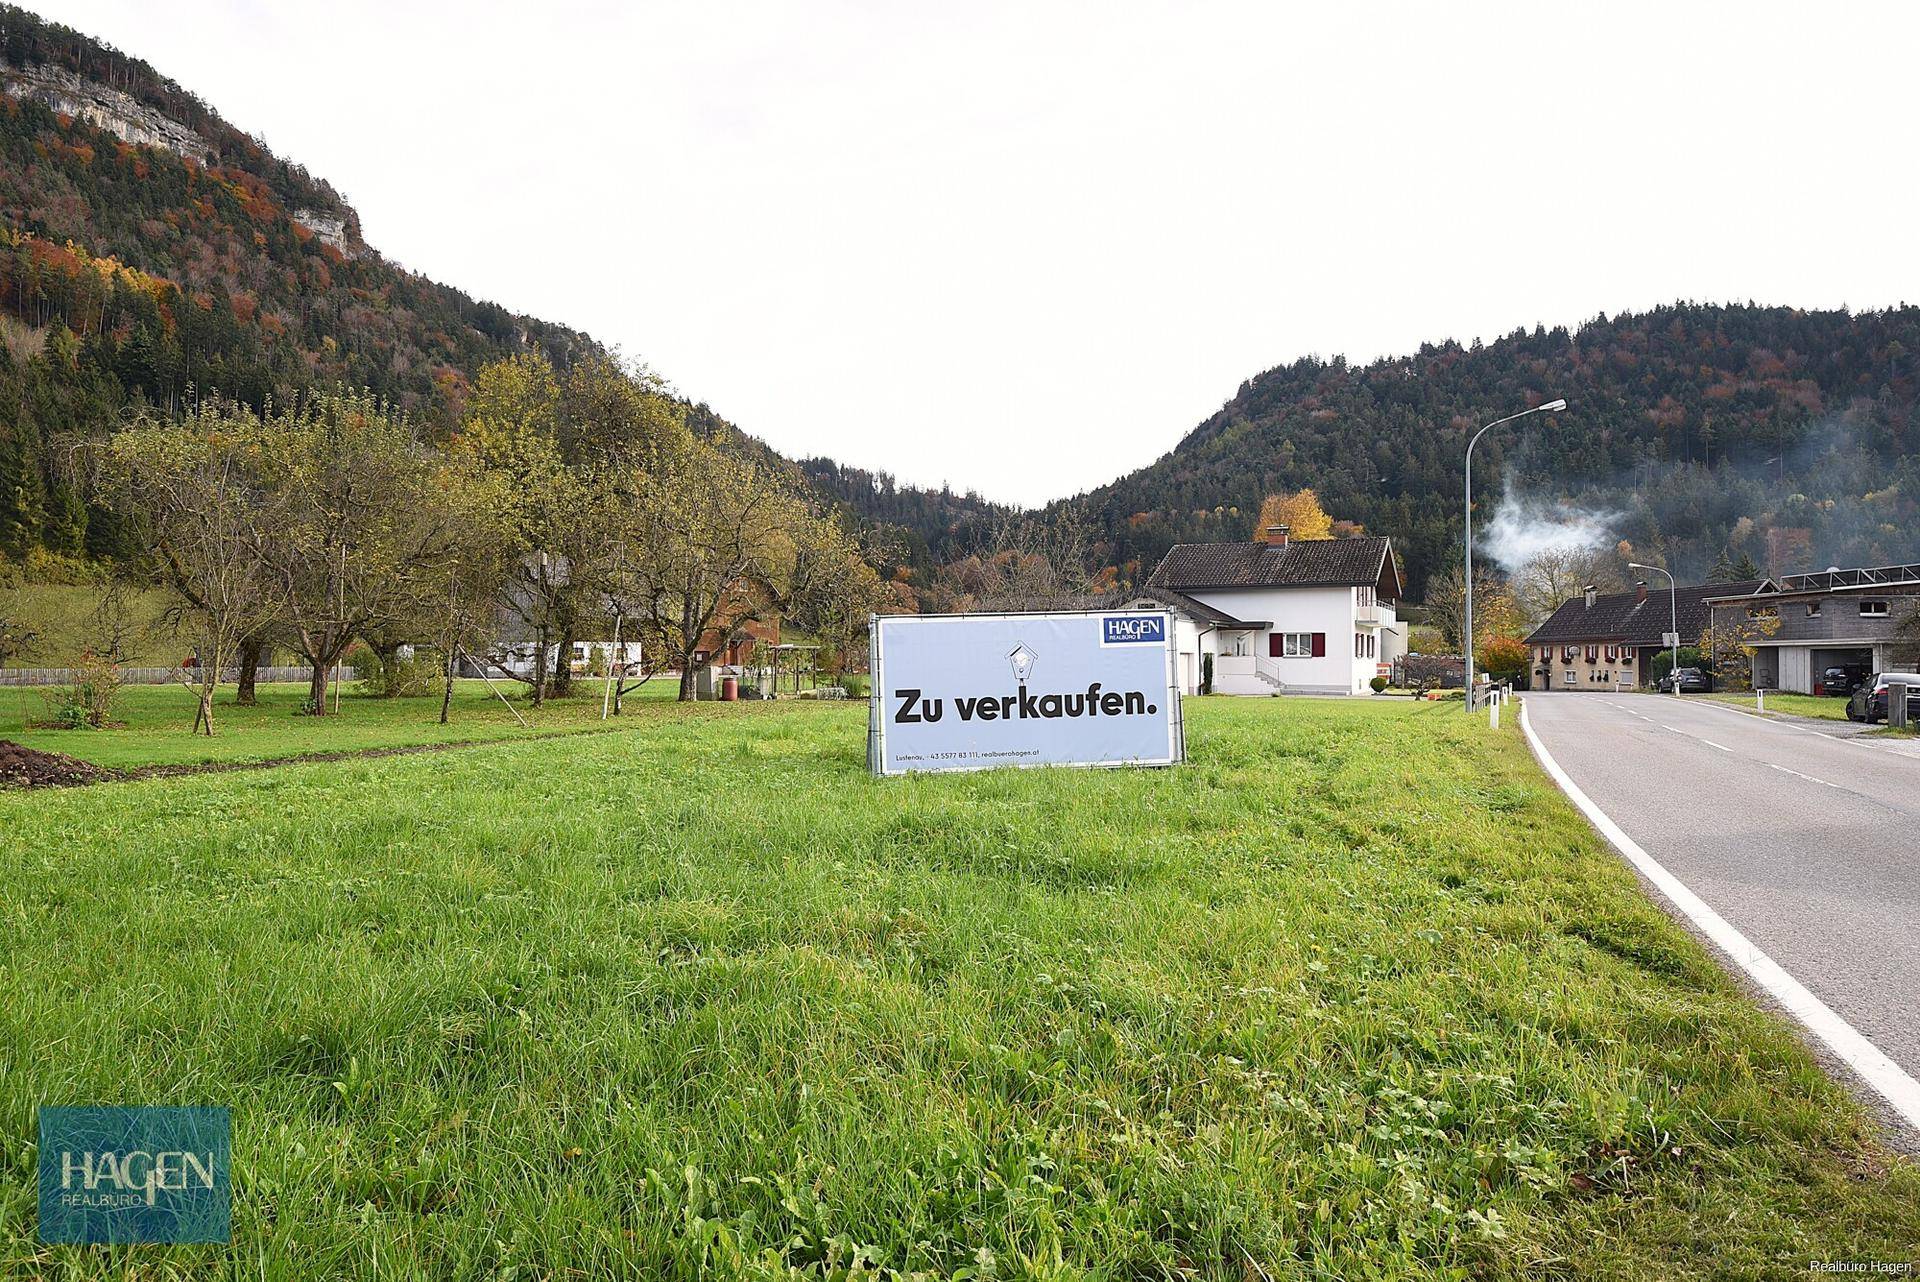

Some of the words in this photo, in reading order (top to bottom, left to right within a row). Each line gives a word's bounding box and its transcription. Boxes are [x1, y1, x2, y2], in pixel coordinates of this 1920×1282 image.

[1108, 619, 1160, 640] HAGEN
[895, 689, 943, 724] Zu
[955, 683, 1158, 721] verkaufen.
[941, 752, 957, 760] 5577
